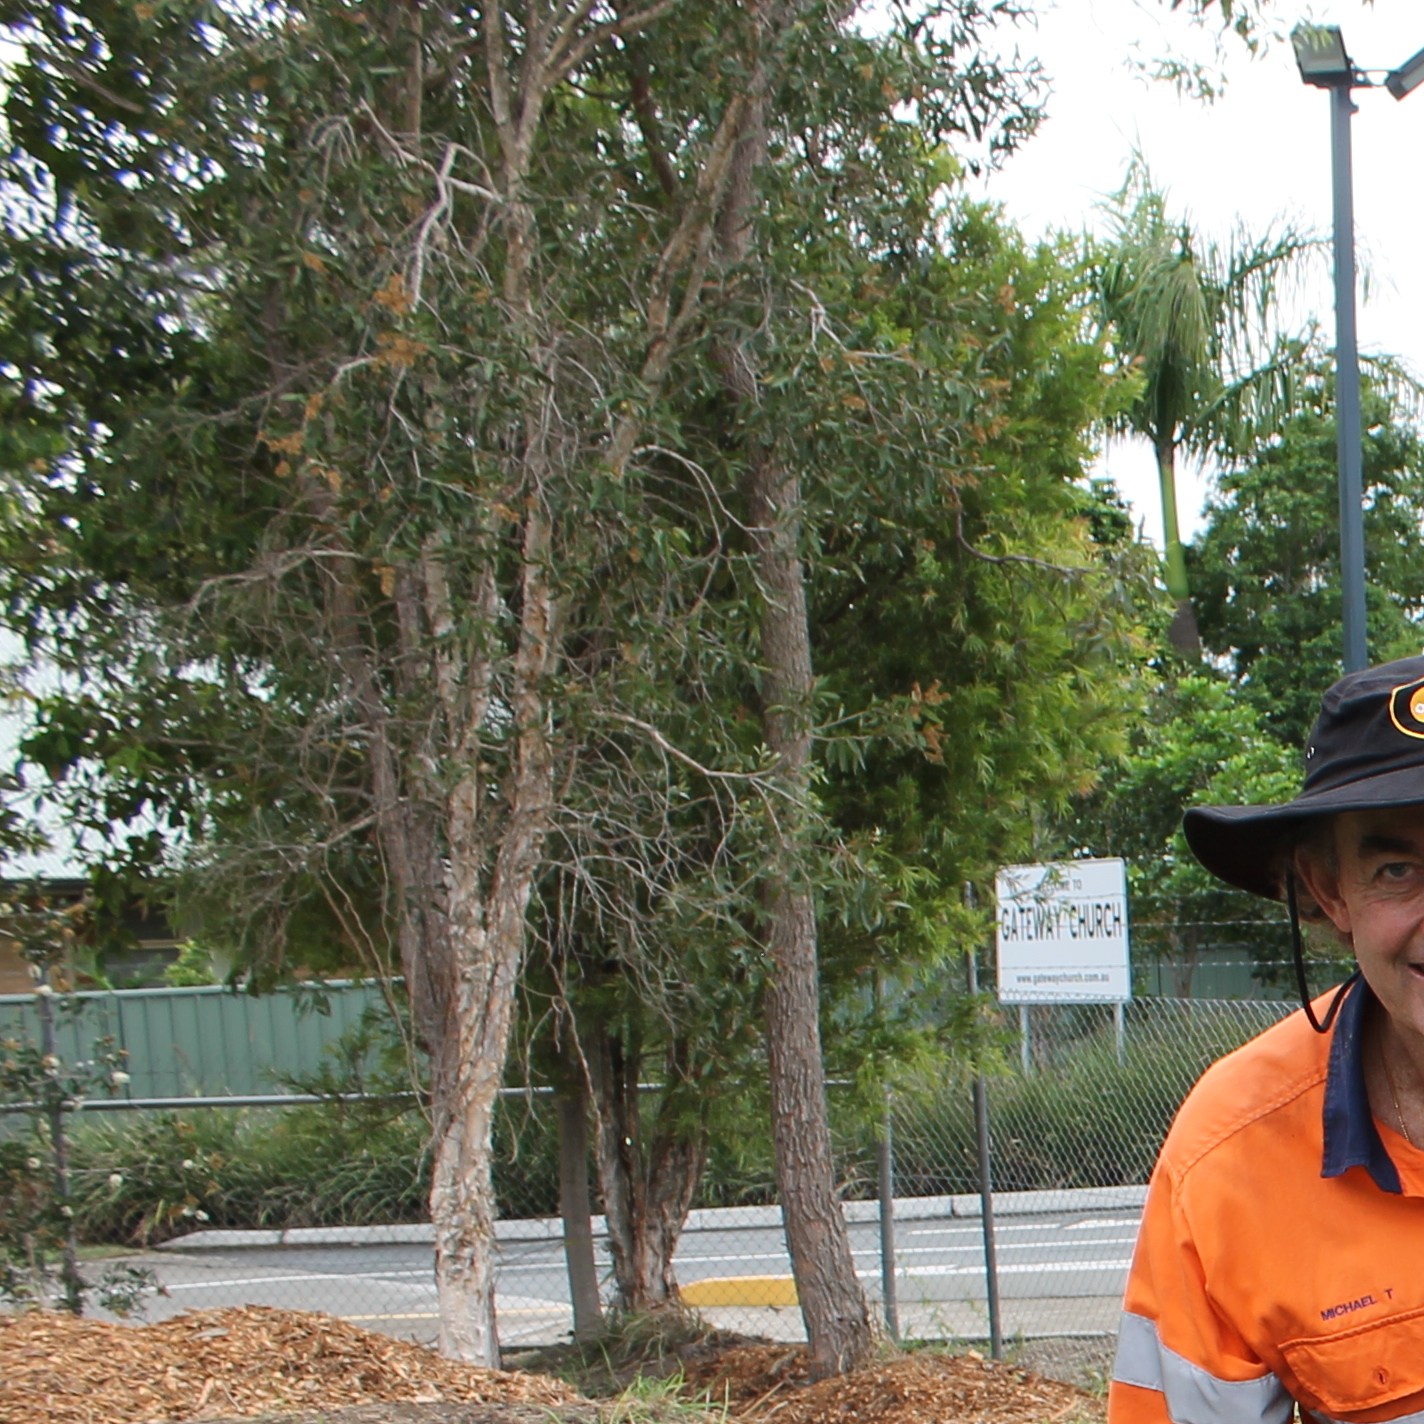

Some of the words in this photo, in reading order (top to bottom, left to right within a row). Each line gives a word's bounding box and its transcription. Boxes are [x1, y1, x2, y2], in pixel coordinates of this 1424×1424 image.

[1001, 905, 1061, 942] GATEWAY
[1069, 903, 1122, 939] CHURCH
[1016, 972, 1110, 986] www.gatewaychurch.com.au
[1320, 1295, 1378, 1321] MICHAEL
[1385, 1288, 1393, 1300] T
